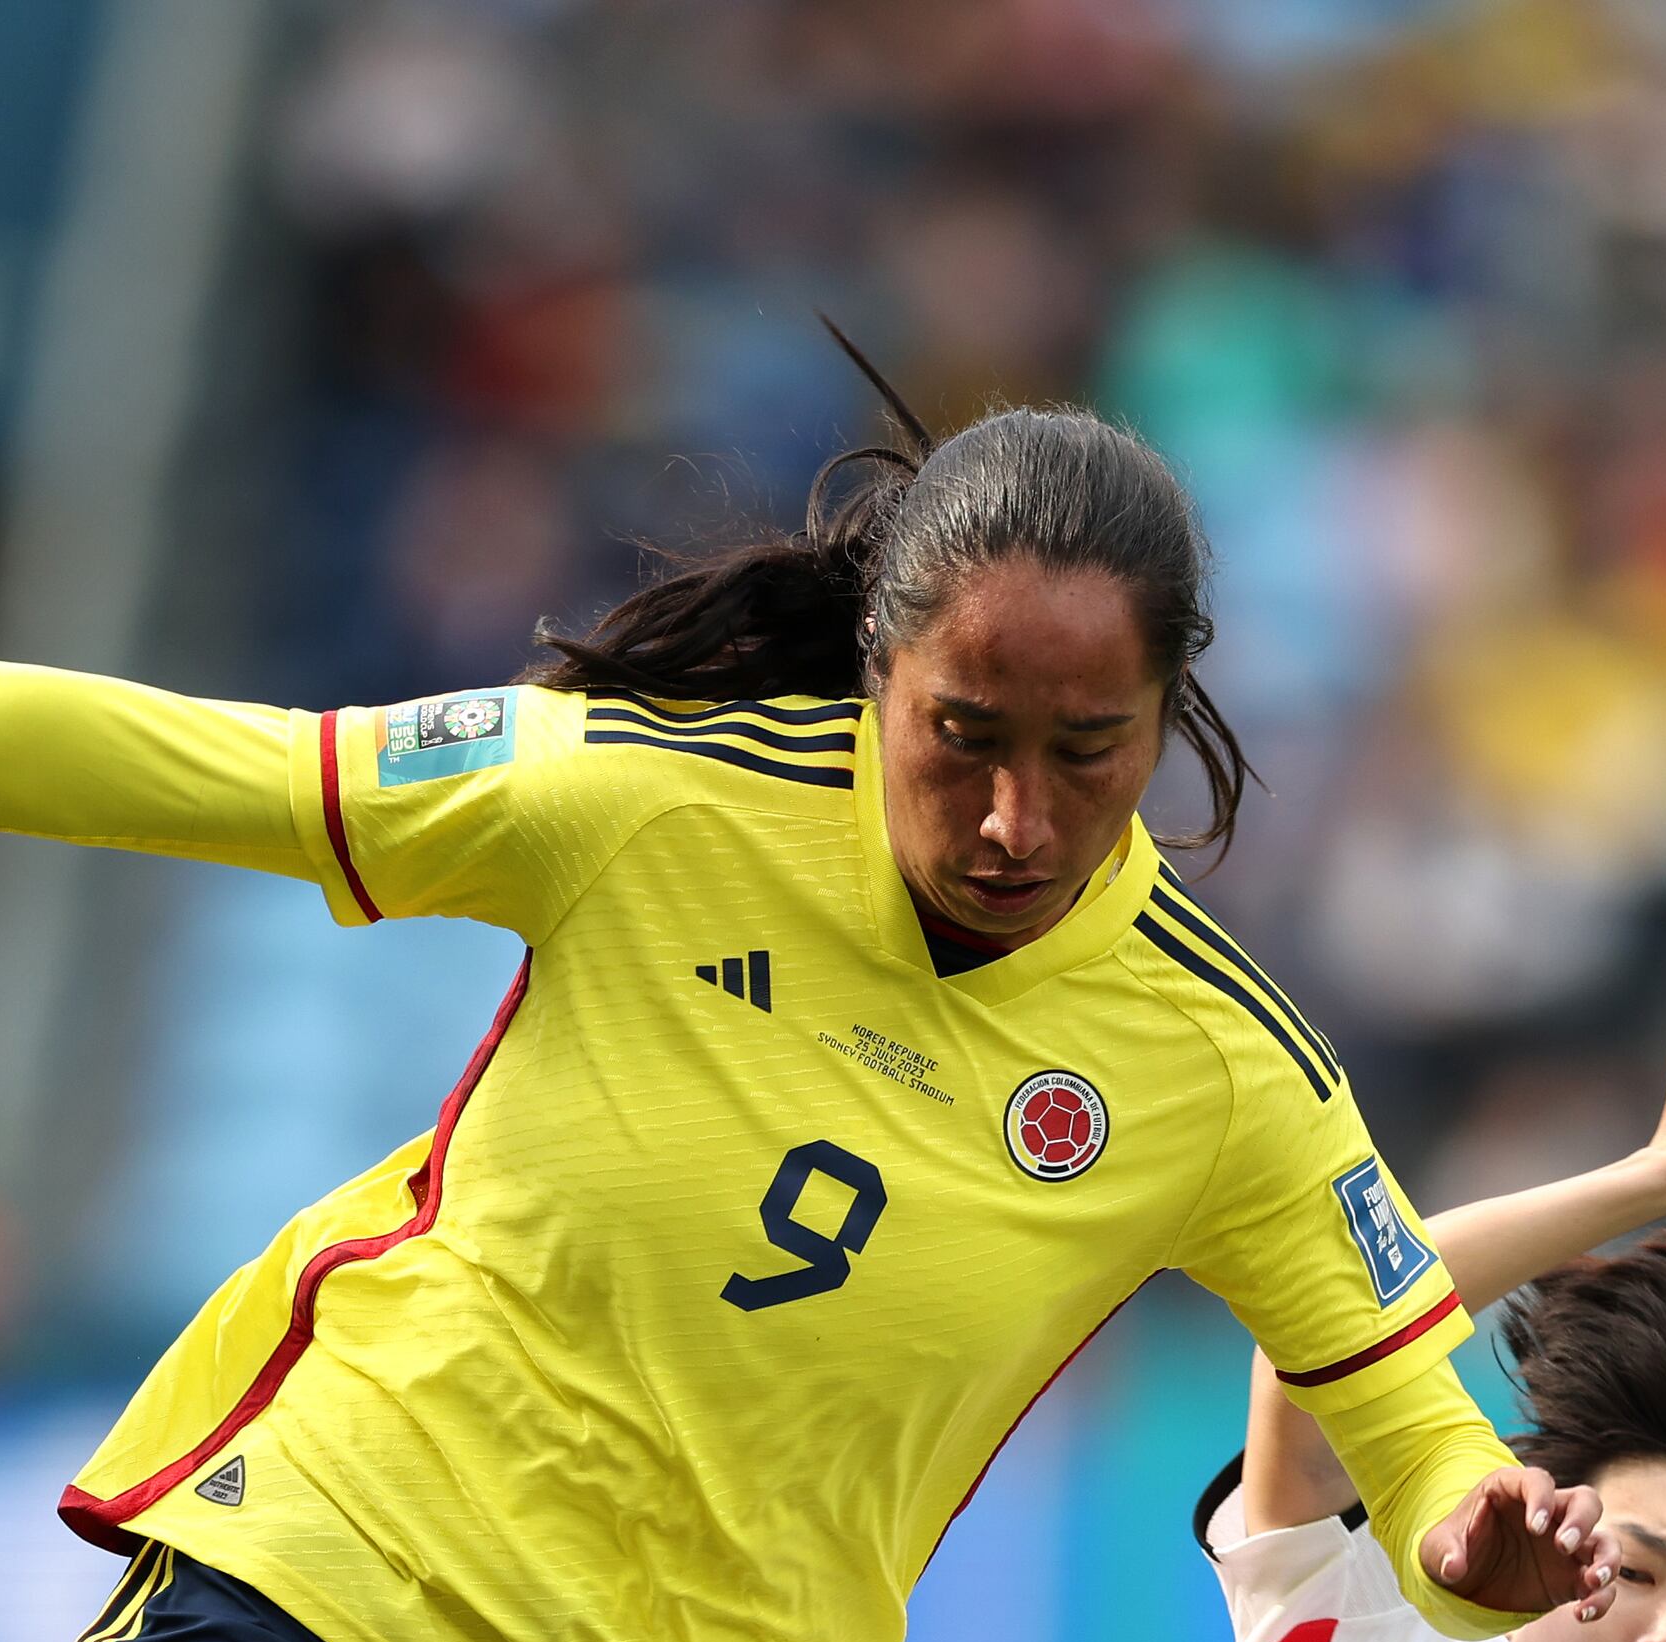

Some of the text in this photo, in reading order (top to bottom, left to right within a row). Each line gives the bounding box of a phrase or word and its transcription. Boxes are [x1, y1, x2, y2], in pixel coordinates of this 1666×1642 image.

[817, 1032, 954, 1106] SYDNEY FOOTBALL STADIUM
[852, 1024, 938, 1071] KOREA REPUBLIC
[855, 1039, 925, 1078] 25 JULY 2023
[1015, 1078, 1050, 1109] FEDERACION
[1052, 1077, 1093, 1103] COLOMBIANA
[1090, 1102, 1100, 1111] DE
[720, 1139, 888, 1311] 9
